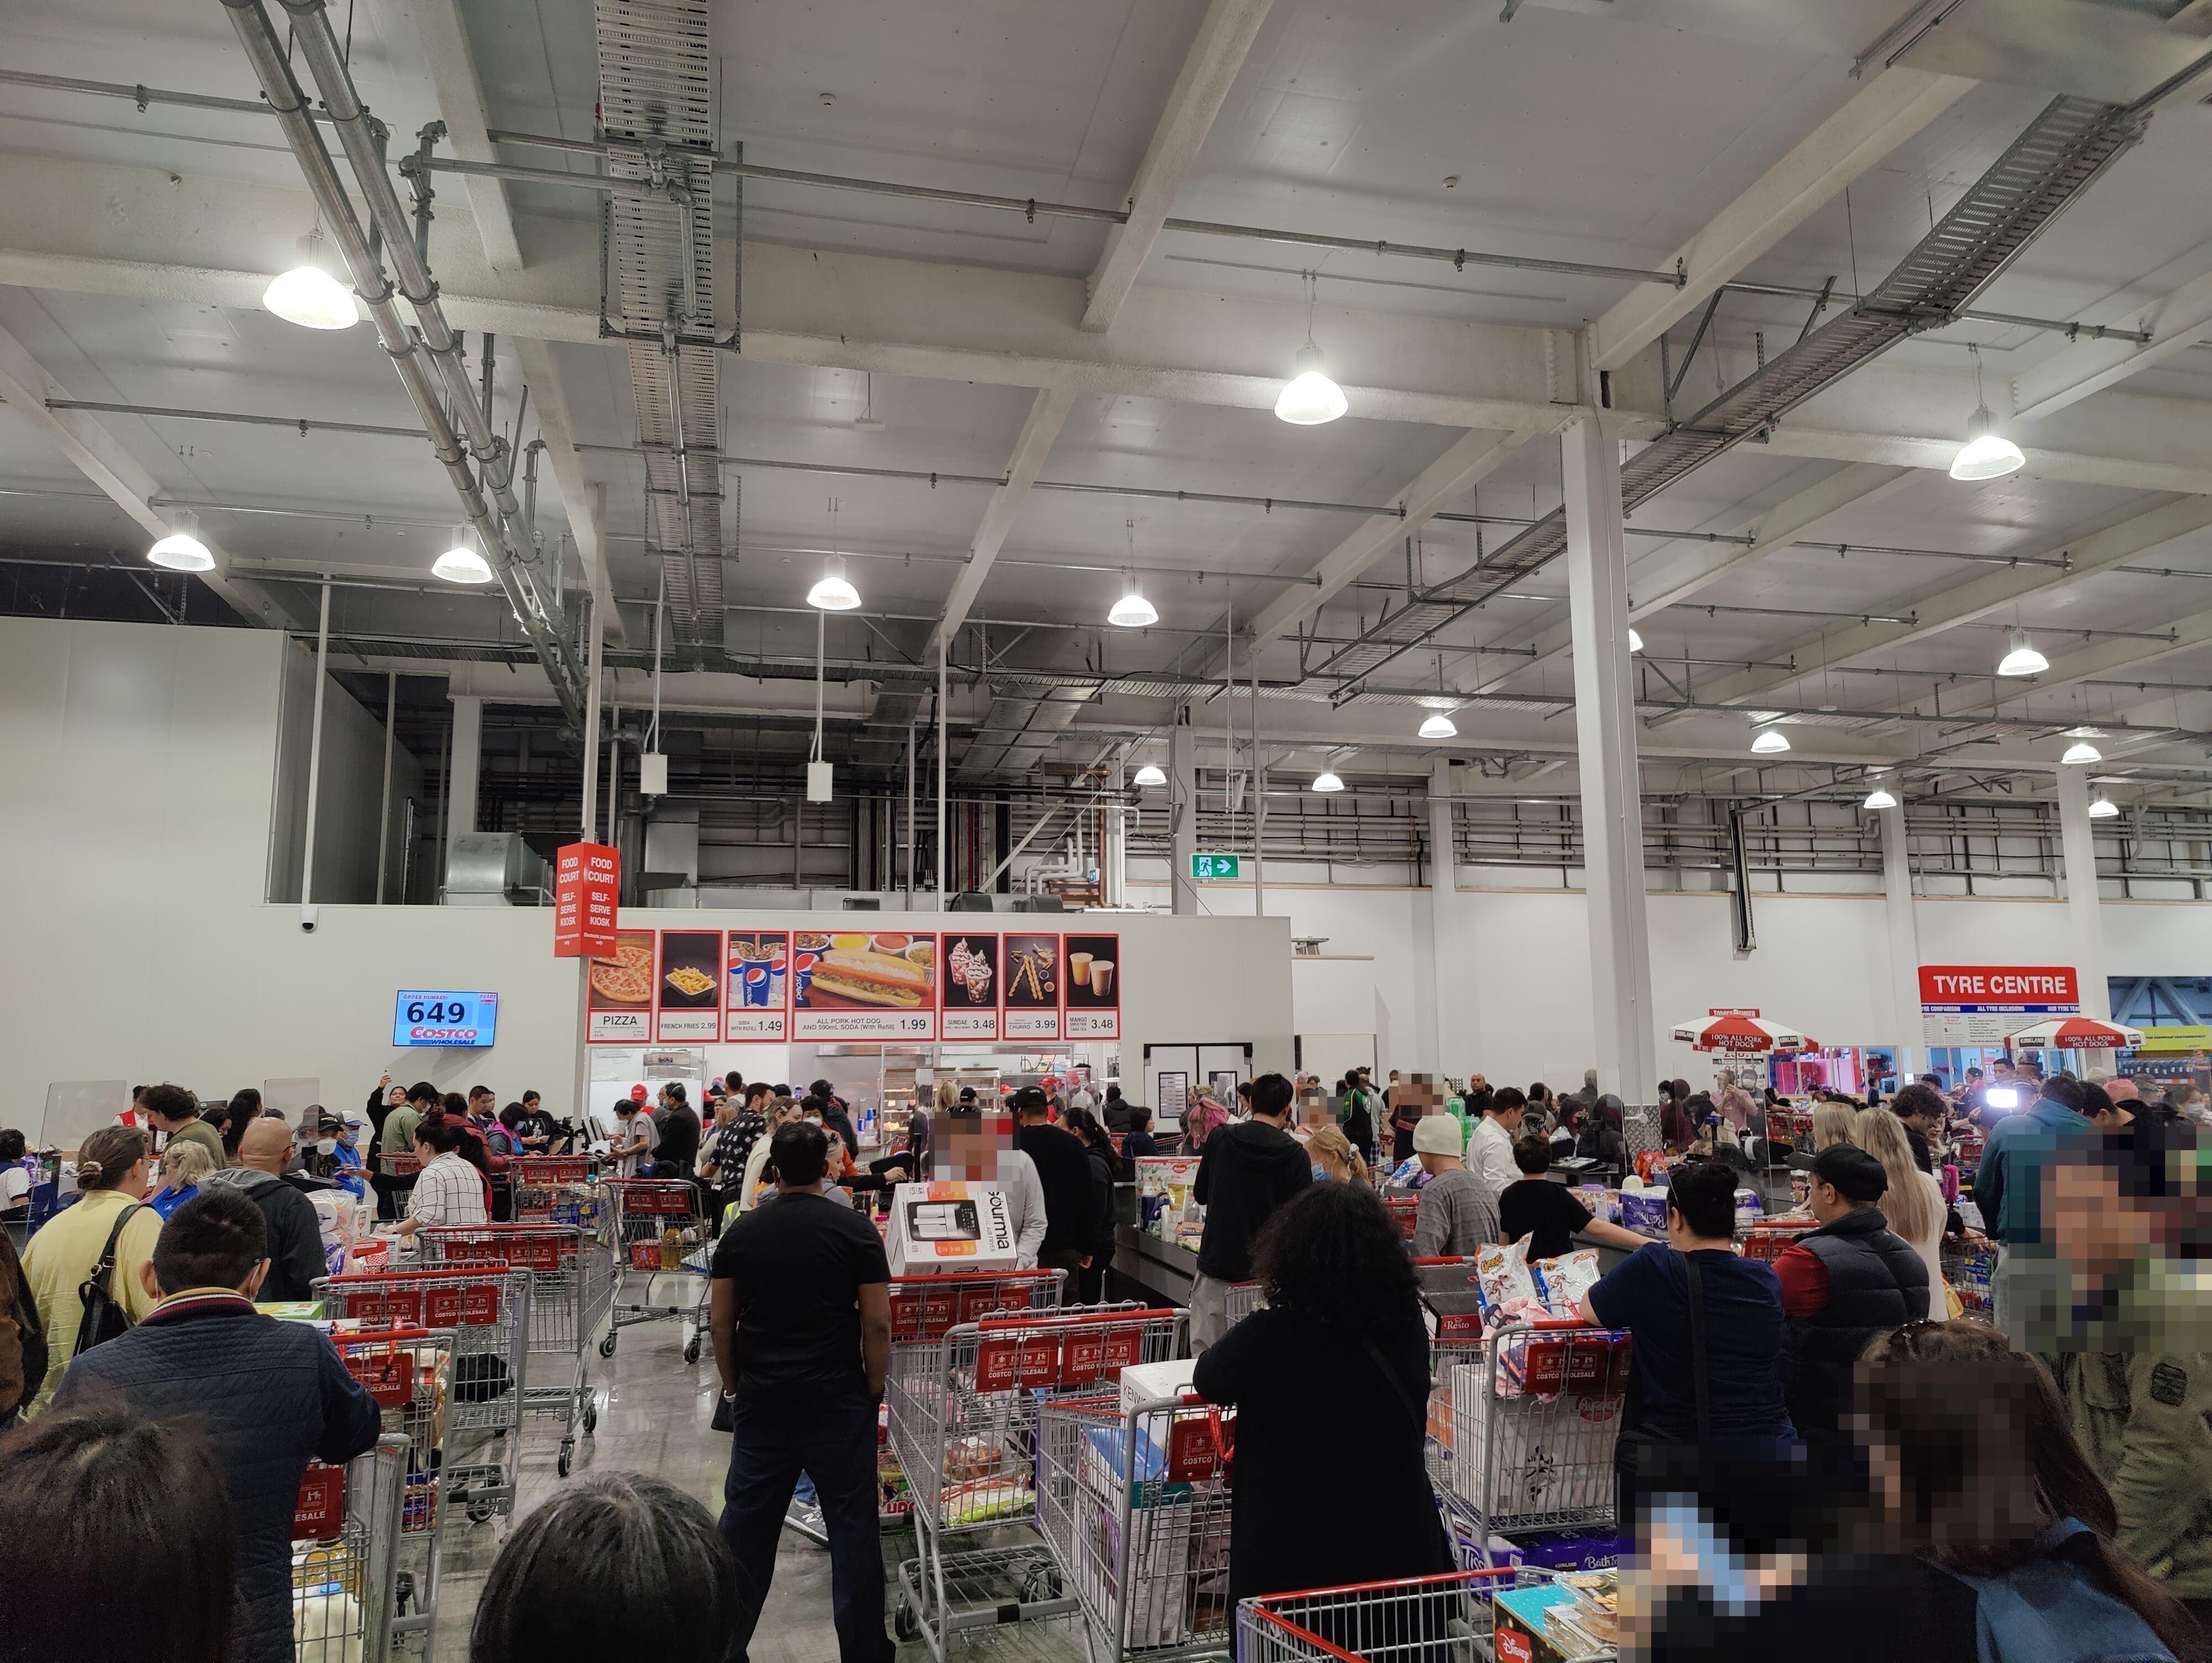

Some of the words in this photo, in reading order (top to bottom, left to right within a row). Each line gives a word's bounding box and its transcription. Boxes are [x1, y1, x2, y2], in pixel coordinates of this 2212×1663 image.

[562, 857, 578, 869] FOOD
[591, 857, 612, 870] FOOD
[560, 871, 580, 884] COURT
[588, 871, 614, 884] COURT
[562, 892, 576, 902] SELF-
[591, 892, 610, 901] SELF-
[560, 904, 577, 914] SERVE
[589, 904, 611, 914] SERVE
[560, 916, 576, 927] KIOSK
[590, 916, 610, 927] KIOSK
[1933, 976, 1985, 994] TYRE
[1990, 976, 2067, 995] CENTRE
[407, 1002, 465, 1023] 649
[603, 1016, 637, 1025] PIZZA
[758, 1021, 782, 1031] 1.49
[900, 1019, 926, 1030] 1.99
[973, 1019, 995, 1029] 3.48
[1035, 1019, 1056, 1029] 3.99
[1091, 1019, 1113, 1029] 3.48
[410, 1026, 478, 1039] COSTCO
[1014, 1368, 1048, 1377] OLESALE
[365, 1384, 400, 1393] OLESALE
[1124, 1382, 1146, 1405] KENW
[1183, 1456, 1212, 1465] COSTCO
[886, 1500, 915, 1514] UD
[295, 1510, 326, 1521] ESALE
[1462, 1544, 1485, 1571] Tiss
[1500, 1633, 1530, 1663] Disney
